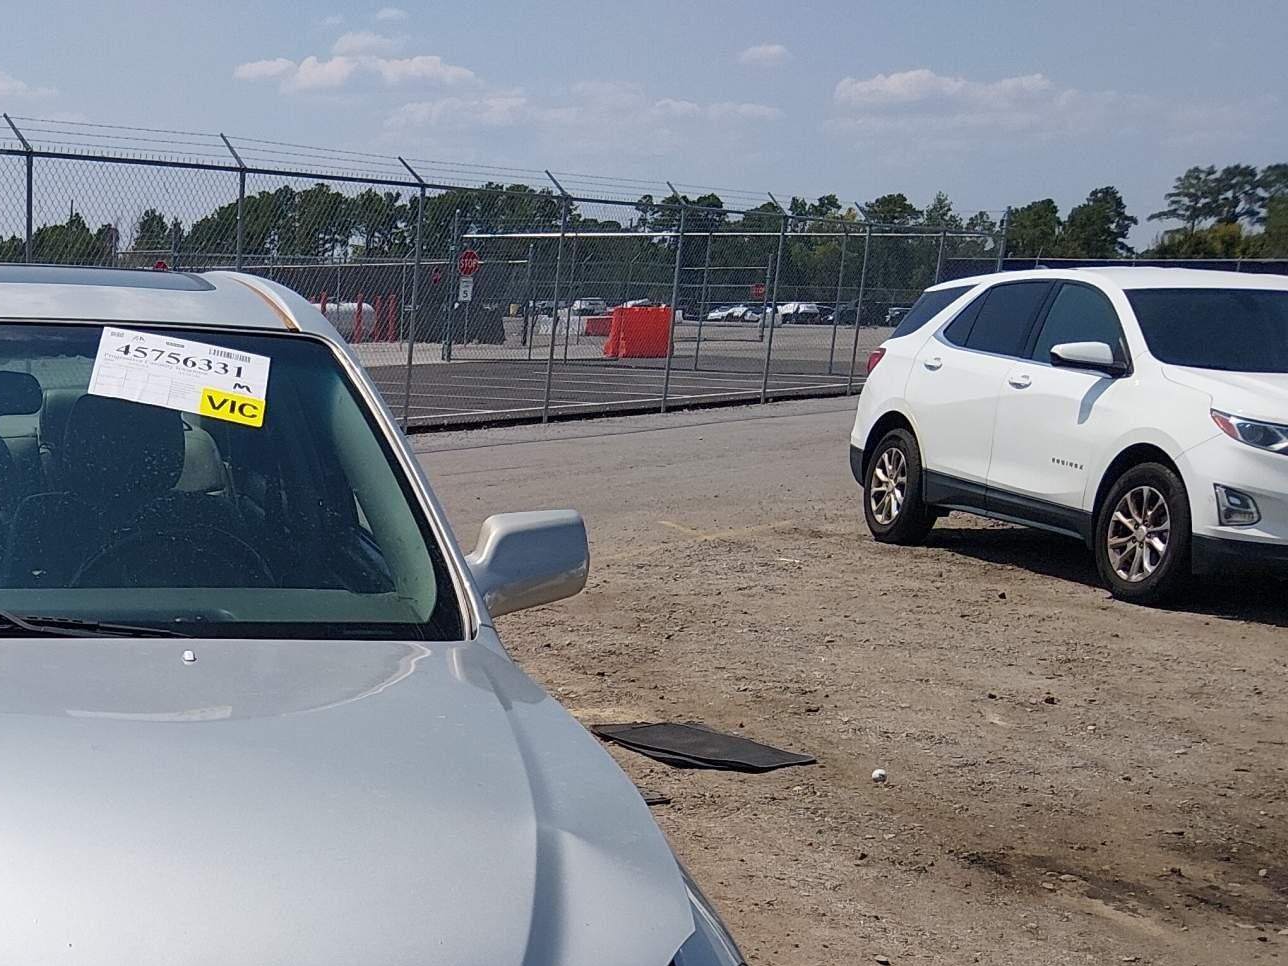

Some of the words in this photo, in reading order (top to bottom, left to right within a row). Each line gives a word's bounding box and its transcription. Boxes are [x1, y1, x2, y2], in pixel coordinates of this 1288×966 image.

[460, 259, 477, 268] STOP
[116, 344, 244, 378] 45756331
[207, 395, 259, 419] VIC
